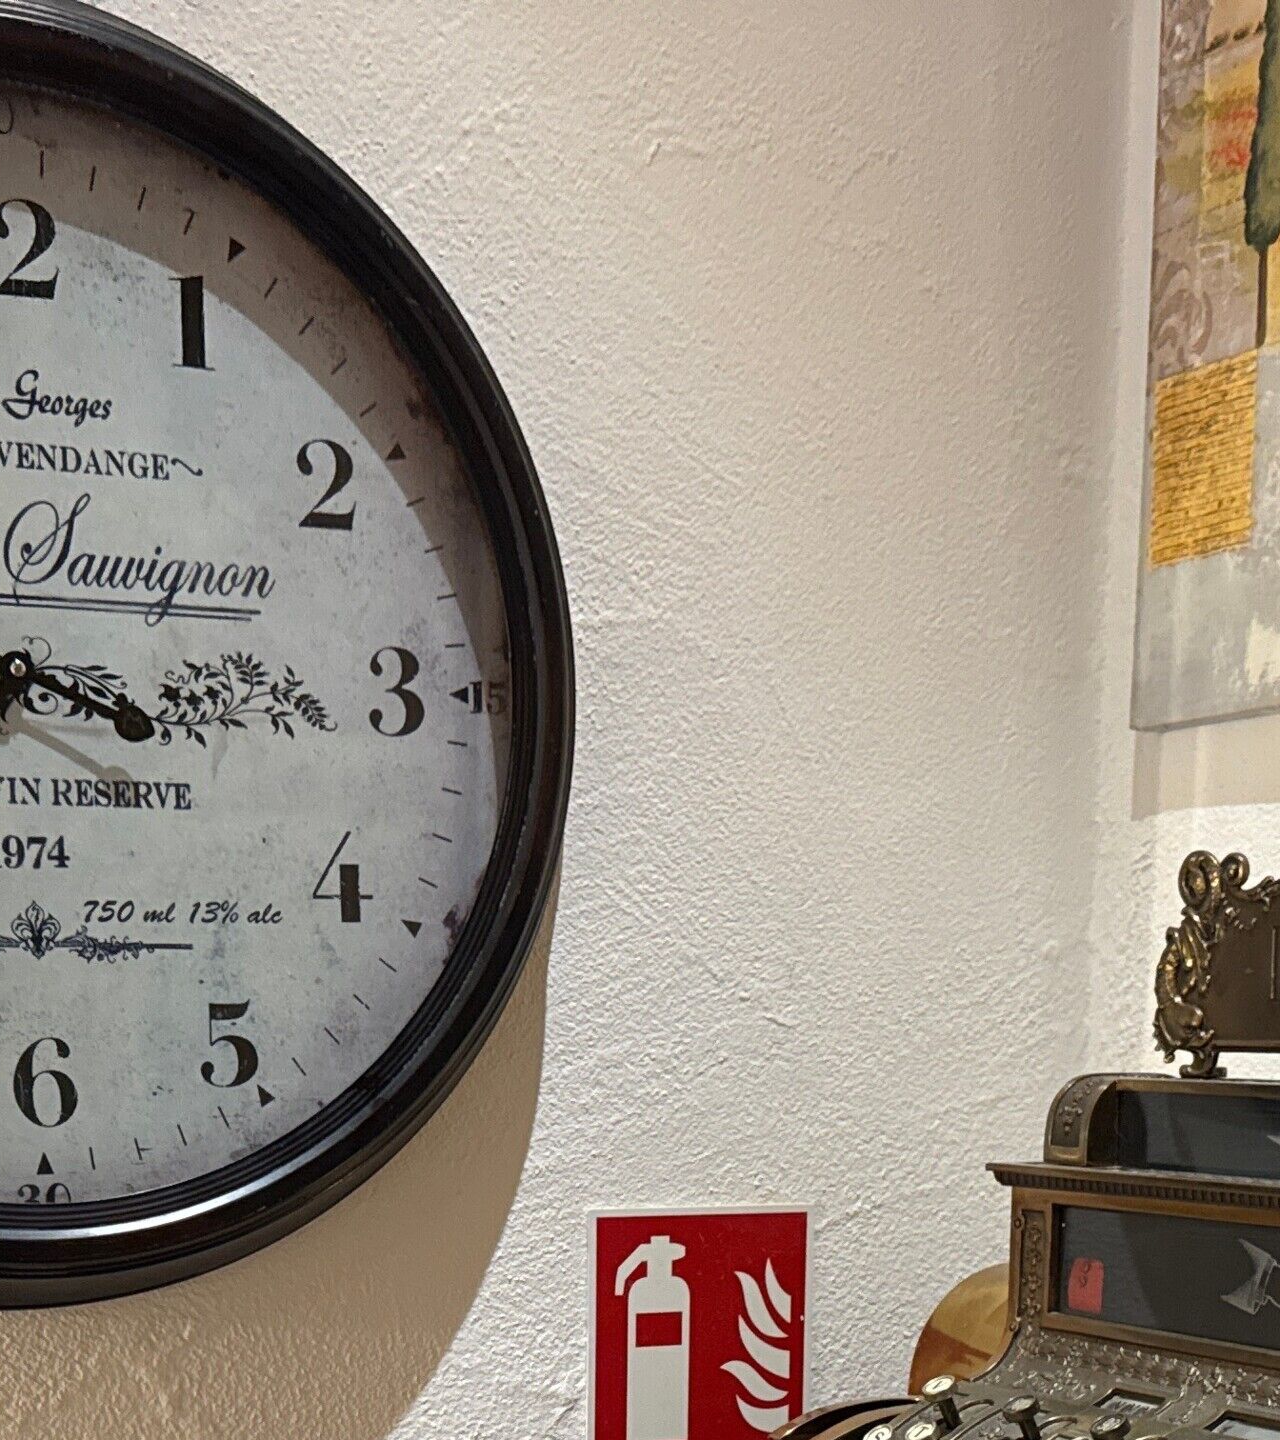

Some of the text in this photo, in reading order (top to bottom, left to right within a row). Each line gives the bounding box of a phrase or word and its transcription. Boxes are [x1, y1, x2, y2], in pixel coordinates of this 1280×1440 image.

[170, 273, 217, 371] 1
[0, 370, 113, 427] Georges
[296, 437, 357, 531] 2
[3, 494, 277, 627] Sauvignon
[369, 646, 425, 737] 3
[51, 779, 193, 811] RESERVE
[83, 900, 136, 925] 750
[143, 900, 177, 925] ml
[189, 901, 240, 925] 13%
[247, 903, 284, 925] alc
[313, 830, 374, 924] 4
[13, 1036, 79, 1128] 6
[199, 999, 259, 1088] 5
